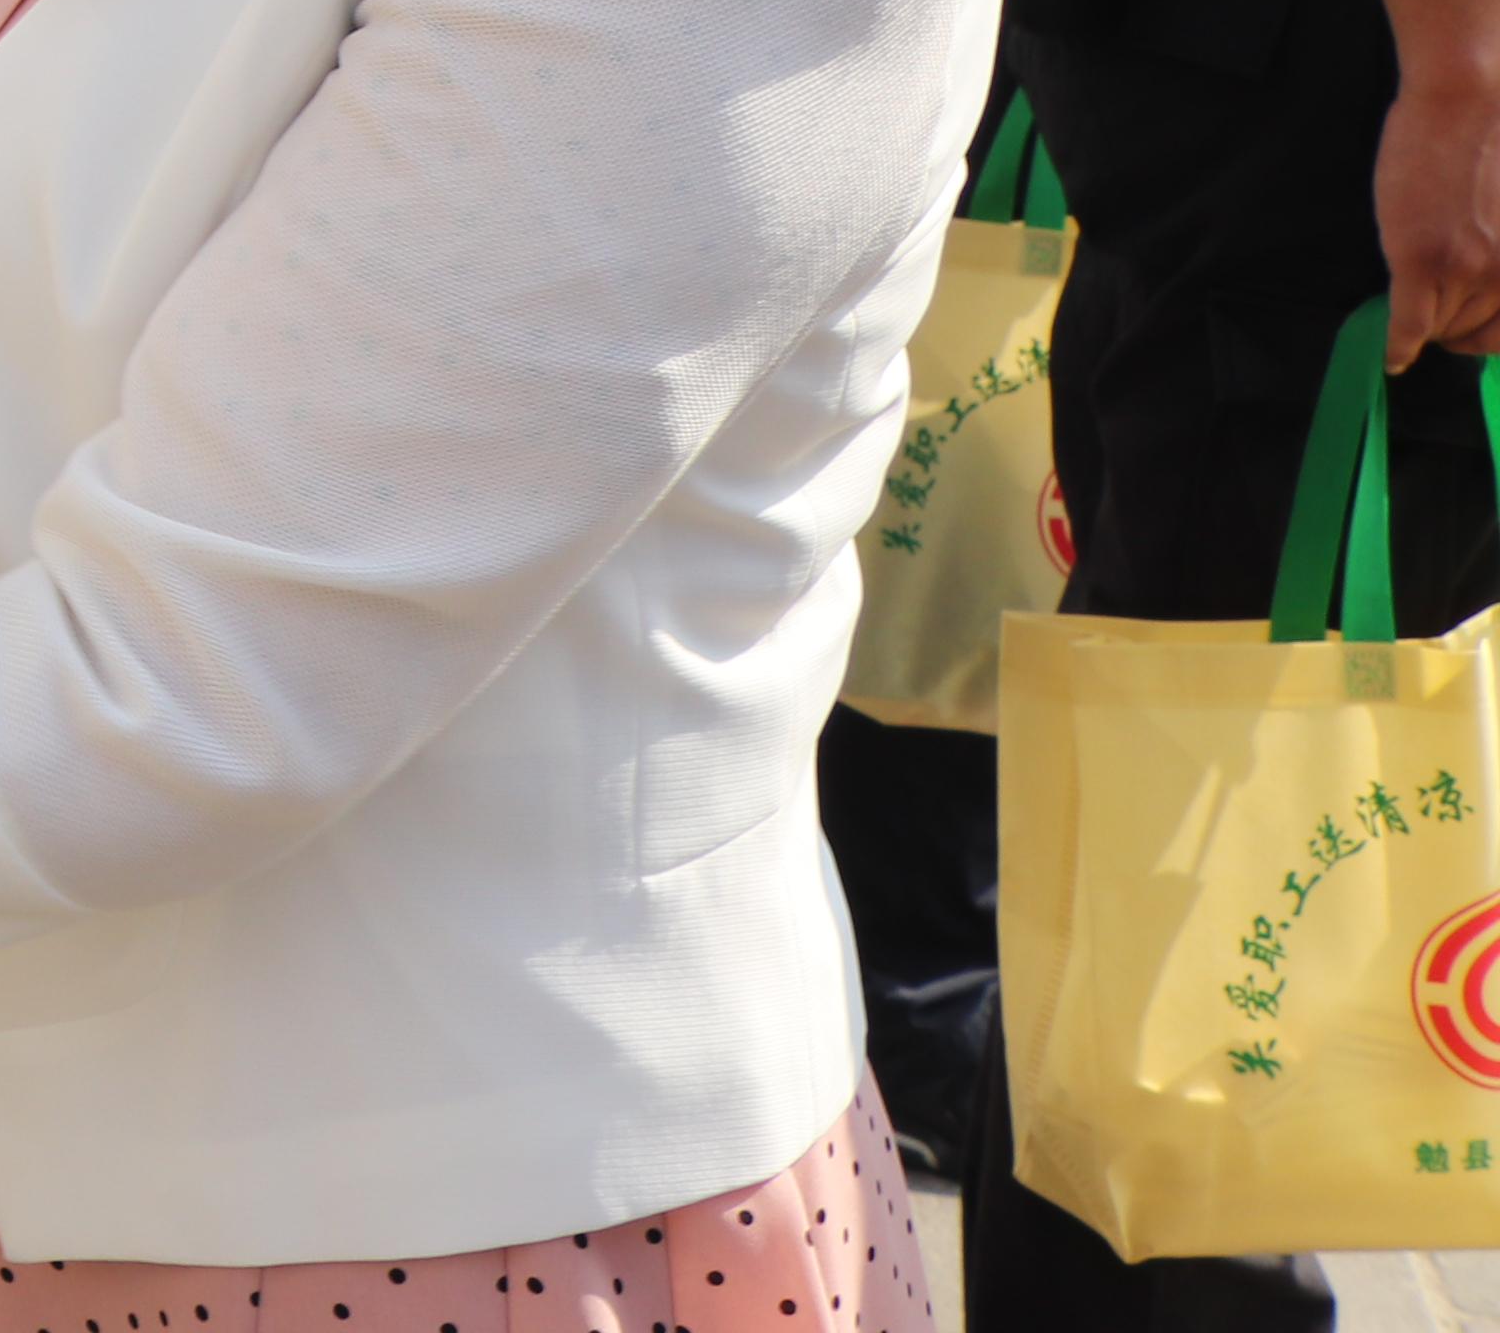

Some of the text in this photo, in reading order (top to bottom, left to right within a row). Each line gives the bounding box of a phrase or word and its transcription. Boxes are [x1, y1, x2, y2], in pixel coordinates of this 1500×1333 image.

[1224, 769, 1475, 1080] 关爱职工送清凉
